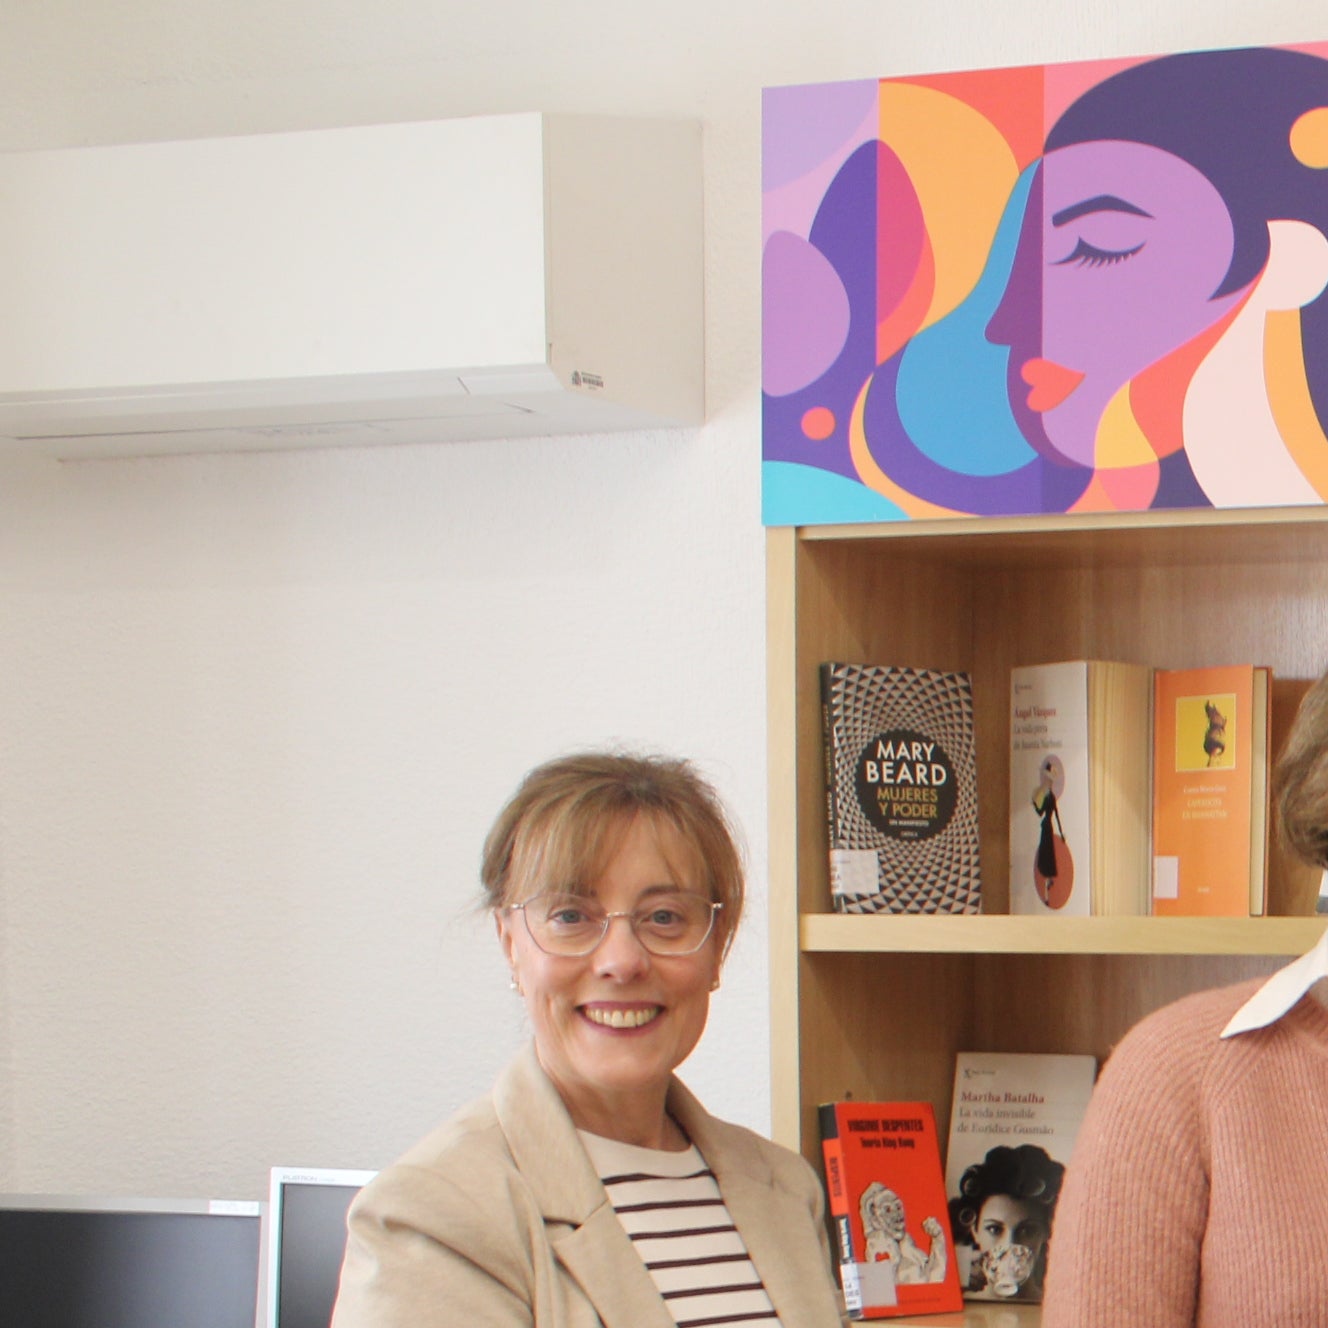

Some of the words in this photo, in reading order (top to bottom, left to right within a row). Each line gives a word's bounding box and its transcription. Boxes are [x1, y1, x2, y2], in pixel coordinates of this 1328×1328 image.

[877, 740, 935, 762] MARY
[866, 760, 947, 786] BEARD
[877, 787, 938, 802] MUJERES
[878, 804, 887, 817] Y
[892, 803, 938, 819] PODER
[961, 1091, 1001, 1103] Martha
[1004, 1091, 1045, 1104] Batalha
[959, 1106, 971, 1117] La
[974, 1107, 994, 1118] vida
